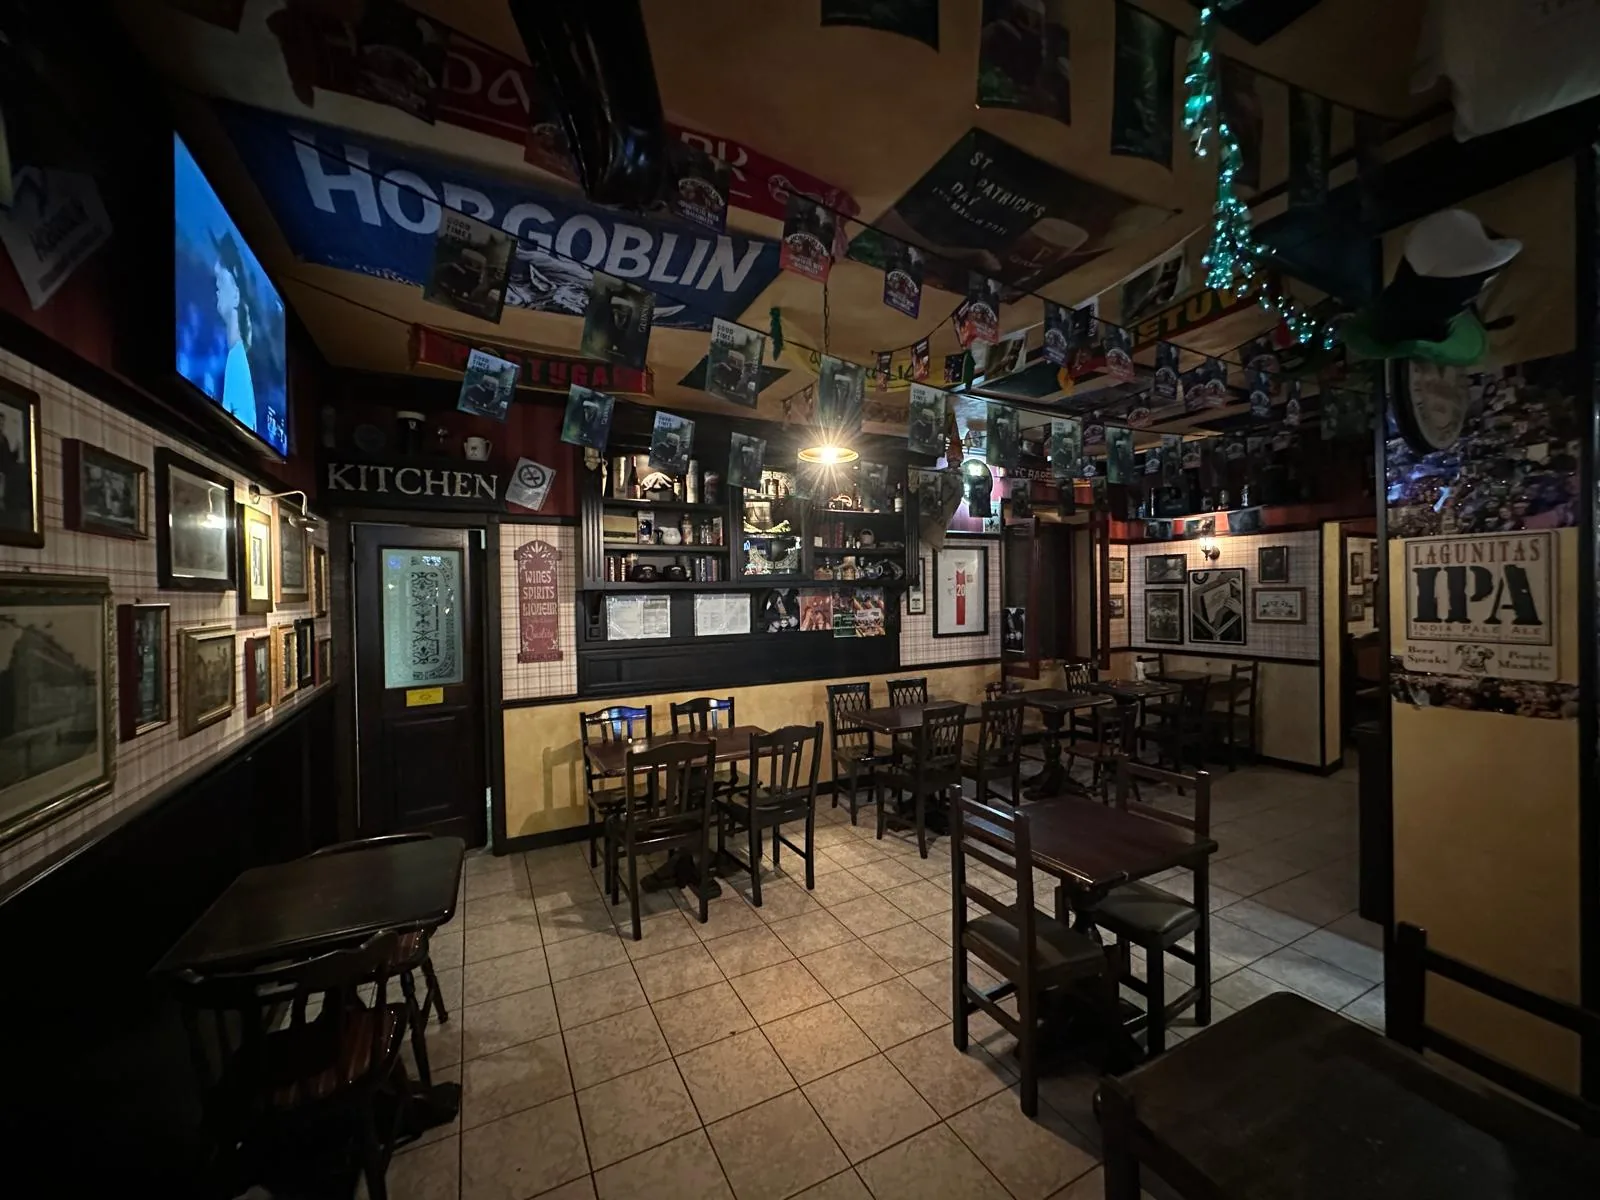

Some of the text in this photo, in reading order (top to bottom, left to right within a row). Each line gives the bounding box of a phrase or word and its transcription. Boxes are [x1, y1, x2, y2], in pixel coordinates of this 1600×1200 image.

[969, 151, 994, 170] ST
[951, 181, 981, 206] DAY
[976, 177, 1048, 219] PATRICK'S
[327, 462, 499, 500] KITCHEN
[1414, 539, 1540, 566] LAGUNITAS
[524, 570, 551, 584] WINES
[522, 585, 555, 600] SPIRITS
[1412, 564, 1544, 625] IPA
[1413, 624, 1542, 635] INDIA PALE ALE
